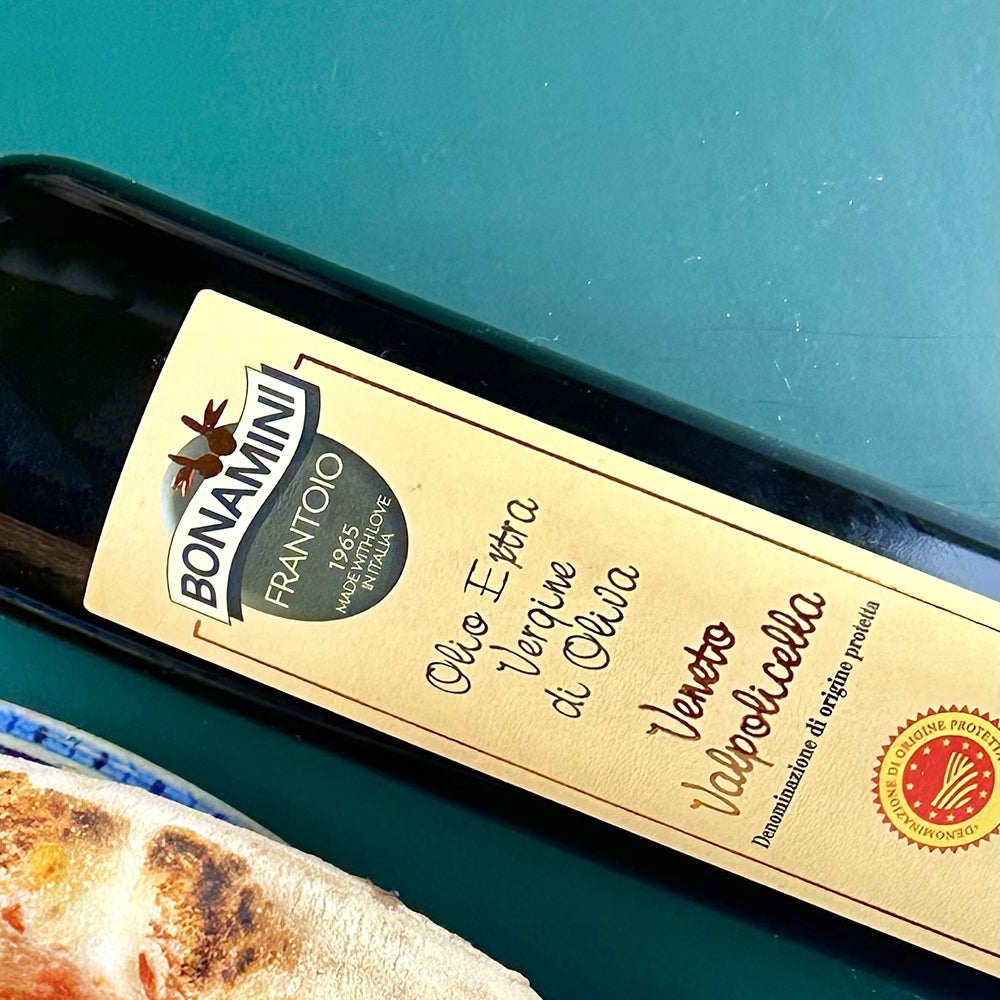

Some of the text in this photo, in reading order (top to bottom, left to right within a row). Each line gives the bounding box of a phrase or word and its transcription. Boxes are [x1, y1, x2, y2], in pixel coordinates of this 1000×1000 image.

[181, 384, 295, 608] BONAMINI
[265, 451, 345, 609] FRANTOIO
[329, 523, 360, 571] 1965
[335, 494, 392, 615] MADE WITH LOVE
[361, 533, 395, 592] IN ITALIA
[425, 497, 539, 695] Olio Extra
[488, 560, 577, 676] Vergine
[544, 564, 641, 719] di Oliva
[638, 621, 736, 741] Veneto
[680, 591, 827, 816] Valpolicella
[751, 600, 881, 849] Denominazione di origine protetta
